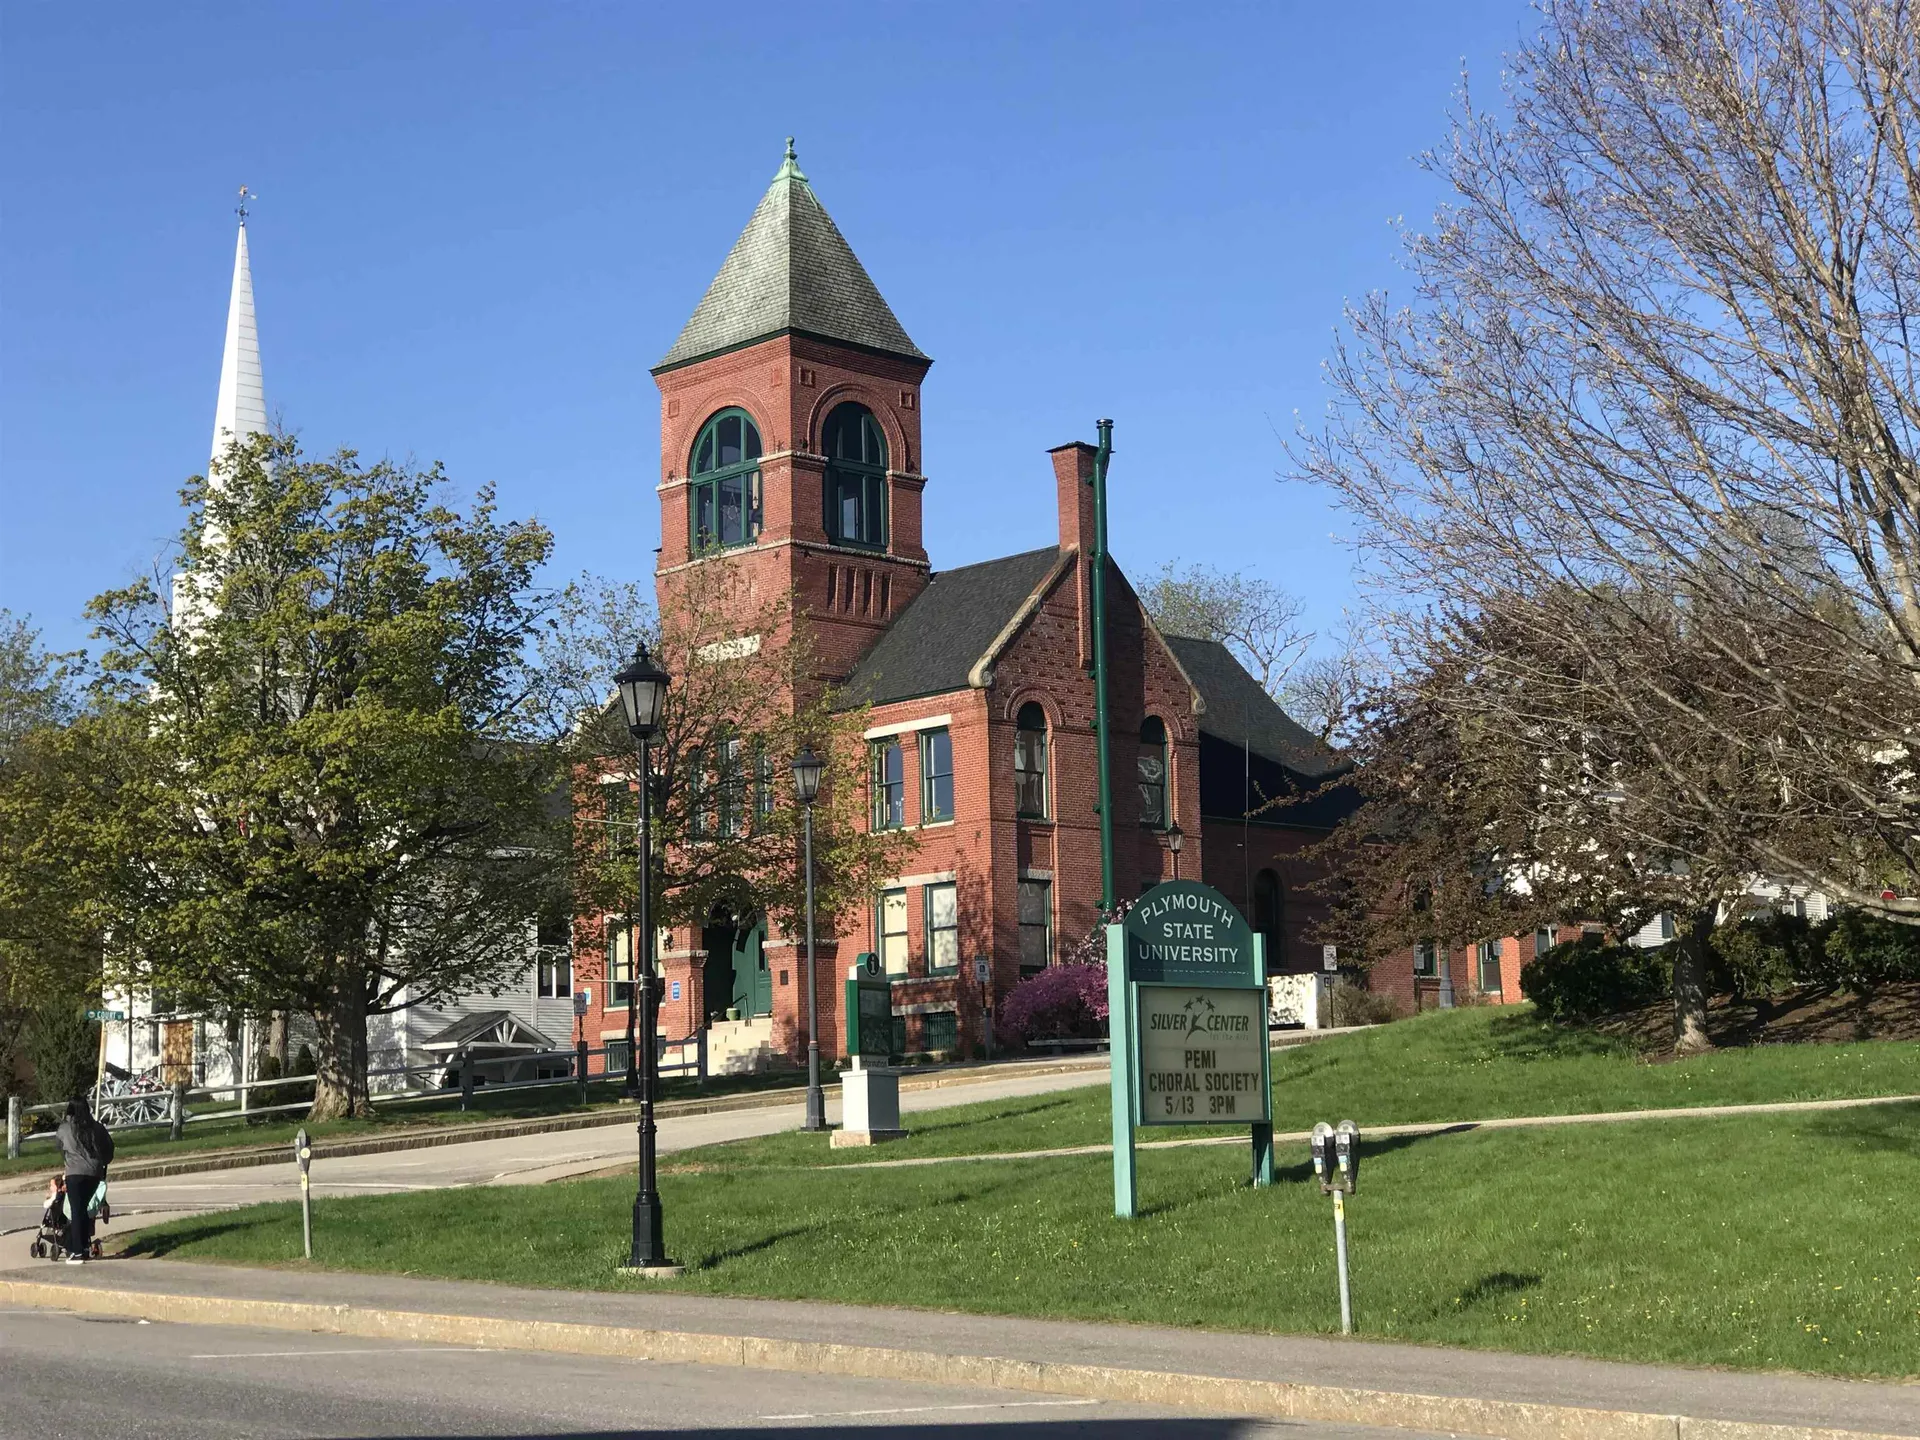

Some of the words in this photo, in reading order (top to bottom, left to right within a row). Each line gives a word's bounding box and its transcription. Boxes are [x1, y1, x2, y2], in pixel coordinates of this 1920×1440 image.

[1141, 894, 1234, 929] PLYMOUTH
[1163, 923, 1214, 939] STATE
[1139, 945, 1238, 963] UNIVERSITY
[1151, 1013, 1187, 1030] SILVER
[1207, 1015, 1249, 1031] CENTER
[1184, 1050, 1216, 1068] PEMI
[1149, 1073, 1199, 1092] CHORAL
[1205, 1073, 1259, 1091] SOCIETY
[1165, 1096, 1194, 1114] 5/13
[1210, 1096, 1235, 1114] 3PM
